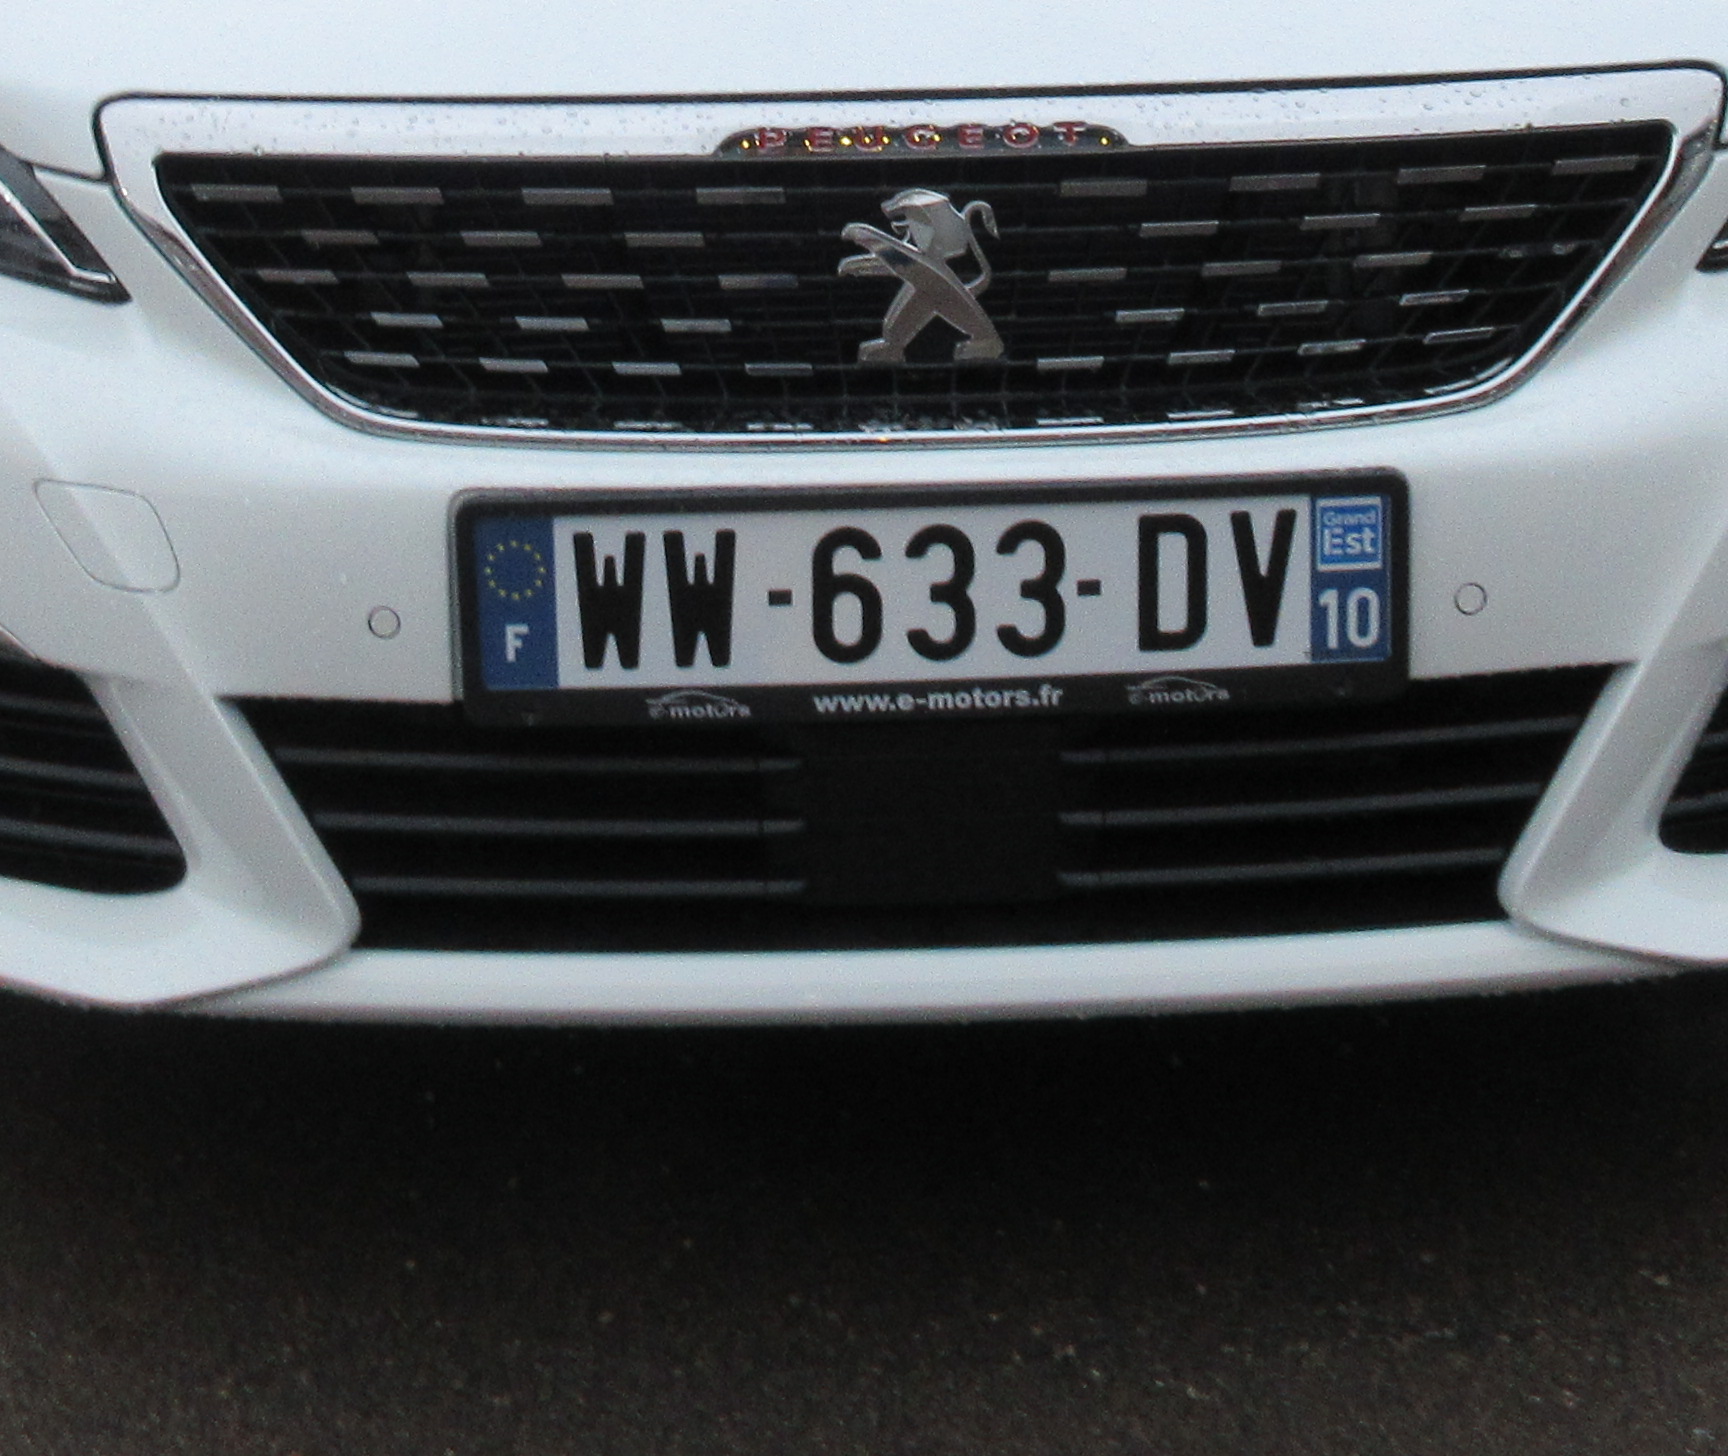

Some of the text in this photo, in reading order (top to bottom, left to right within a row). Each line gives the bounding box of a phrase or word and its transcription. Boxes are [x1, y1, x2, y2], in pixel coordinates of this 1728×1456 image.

[756, 121, 1087, 153] PEUGEOT
[1322, 510, 1377, 526] Grand
[1323, 527, 1376, 556] Est
[573, 508, 1298, 670] WW-633-DV
[1318, 587, 1381, 650] 10
[503, 624, 529, 663] F
[813, 684, 1064, 714] www.e-motors.fr
